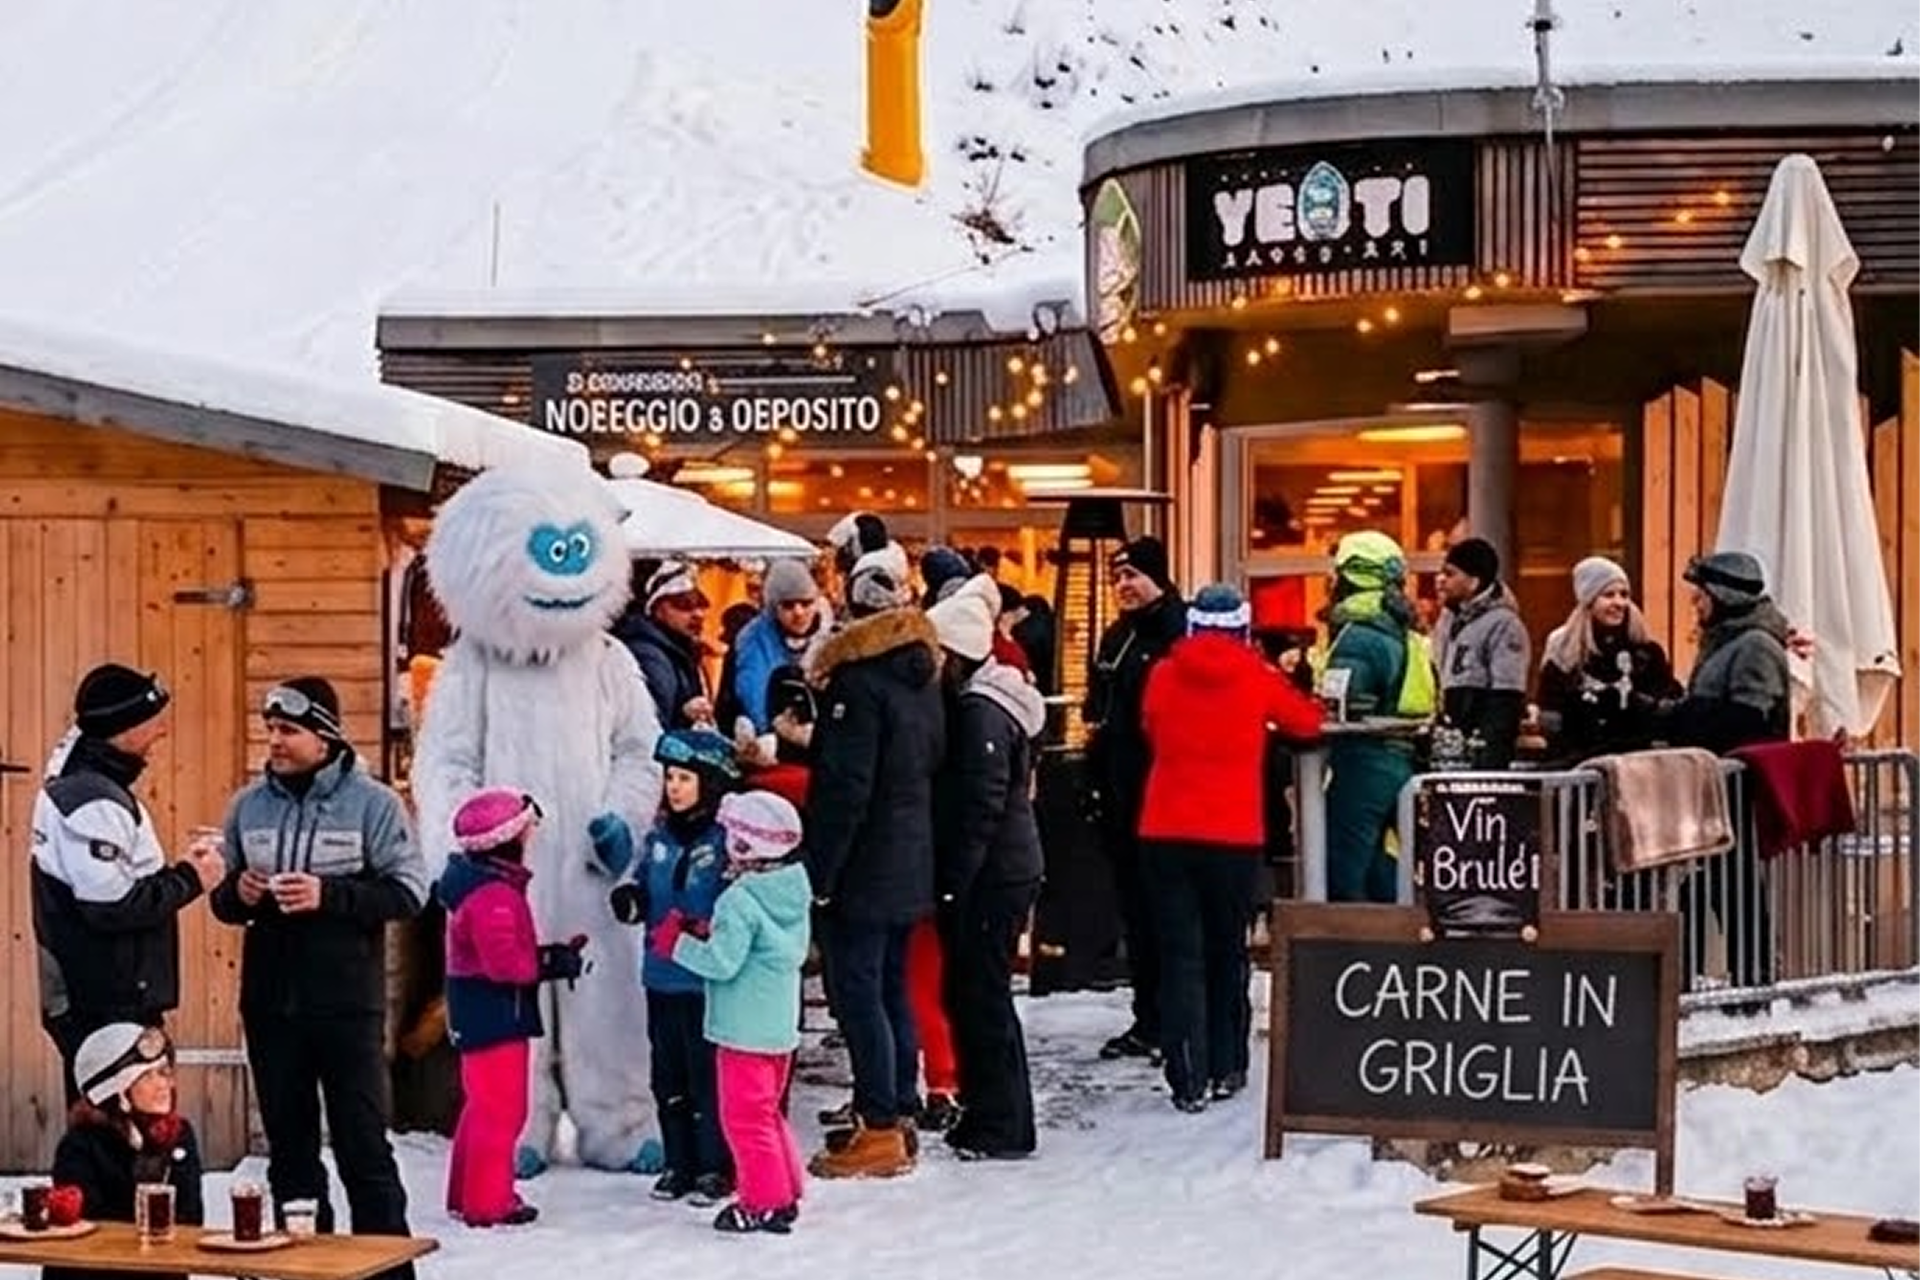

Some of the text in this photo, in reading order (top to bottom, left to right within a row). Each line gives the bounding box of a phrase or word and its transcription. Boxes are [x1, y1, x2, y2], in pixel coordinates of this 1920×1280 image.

[1446, 797, 1507, 844] Vin
[1334, 961, 1617, 1028] CARNE IN
[1359, 1038, 1590, 1105] GRIGLIA
